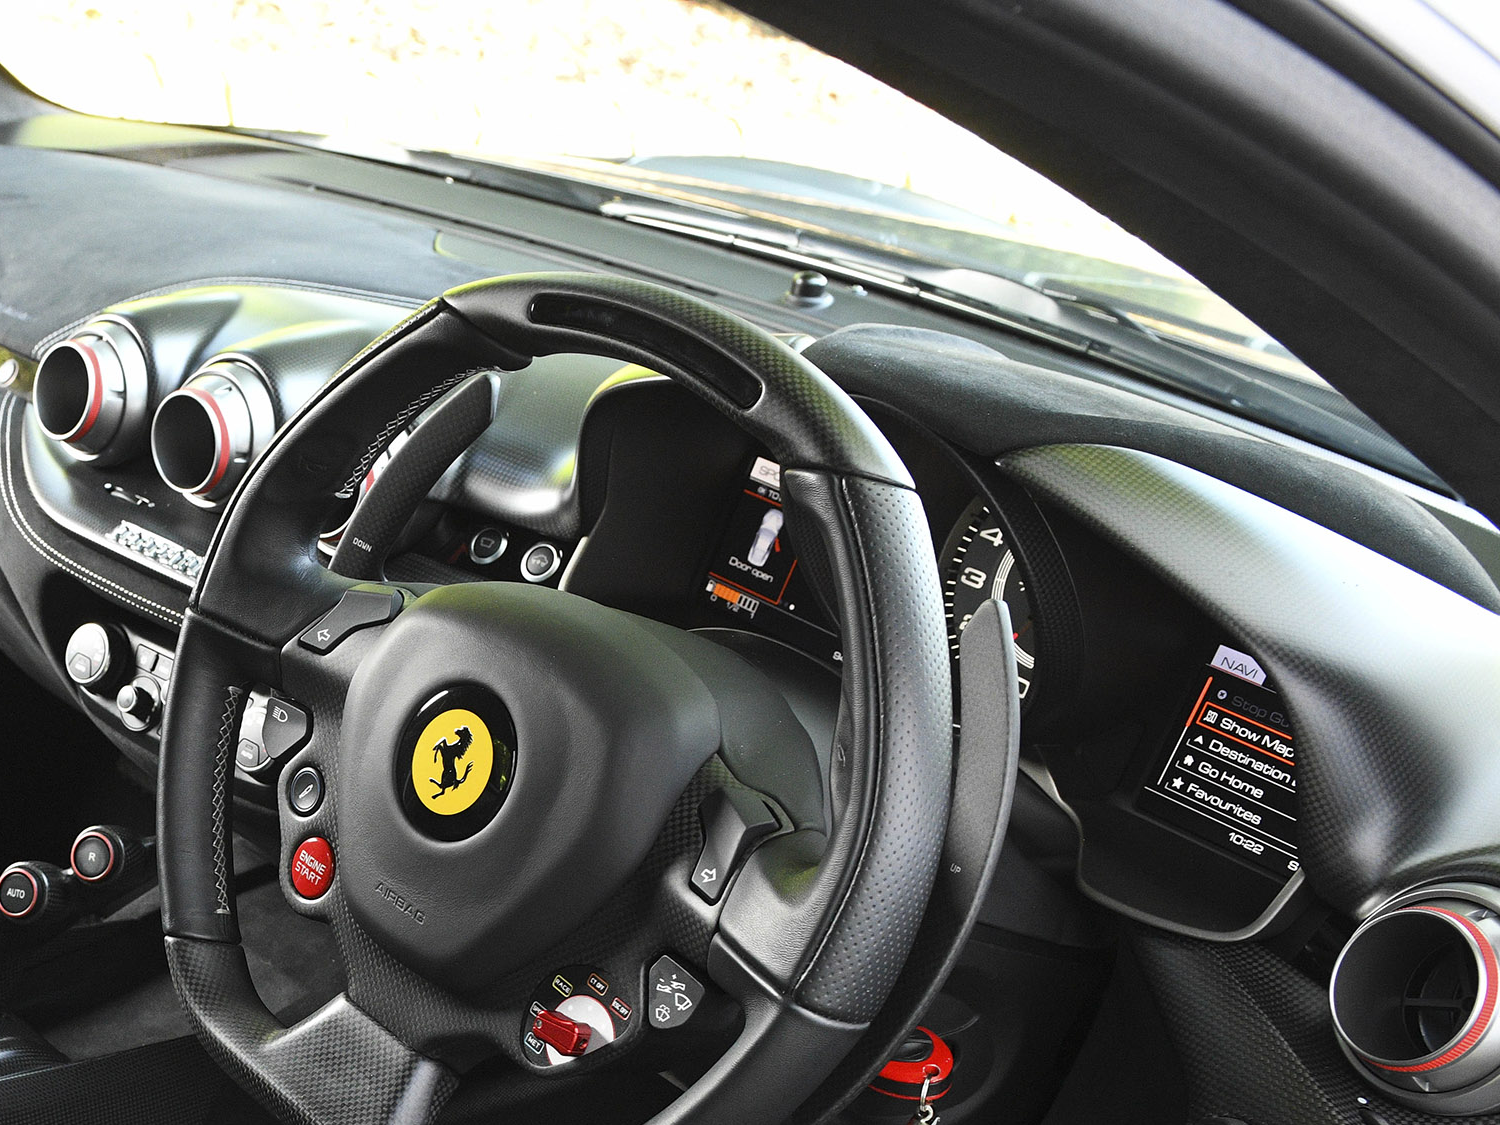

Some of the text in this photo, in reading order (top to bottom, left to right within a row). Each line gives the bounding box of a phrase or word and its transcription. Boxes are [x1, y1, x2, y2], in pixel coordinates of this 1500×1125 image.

[352, 537, 372, 552] DOWN
[980, 527, 1004, 547] 4
[728, 556, 774, 583] Door open
[960, 566, 987, 589] 3
[1220, 656, 1259, 679] NAVI
[1231, 695, 1267, 719] Stop
[1219, 717, 1295, 759] Show Map
[1208, 740, 1292, 783] Destination
[1198, 761, 1264, 799] Go Home
[1187, 783, 1262, 825] Favourites
[1228, 832, 1264, 855] 10:22
[88, 851, 96, 862] R
[299, 849, 326, 876] ENGINE
[295, 861, 321, 886] START
[950, 863, 962, 874] UP
[6, 887, 25, 899] AUTO
[375, 881, 426, 925] AIRBAG
[554, 978, 571, 994] RACE
[527, 1037, 540, 1049] WET
